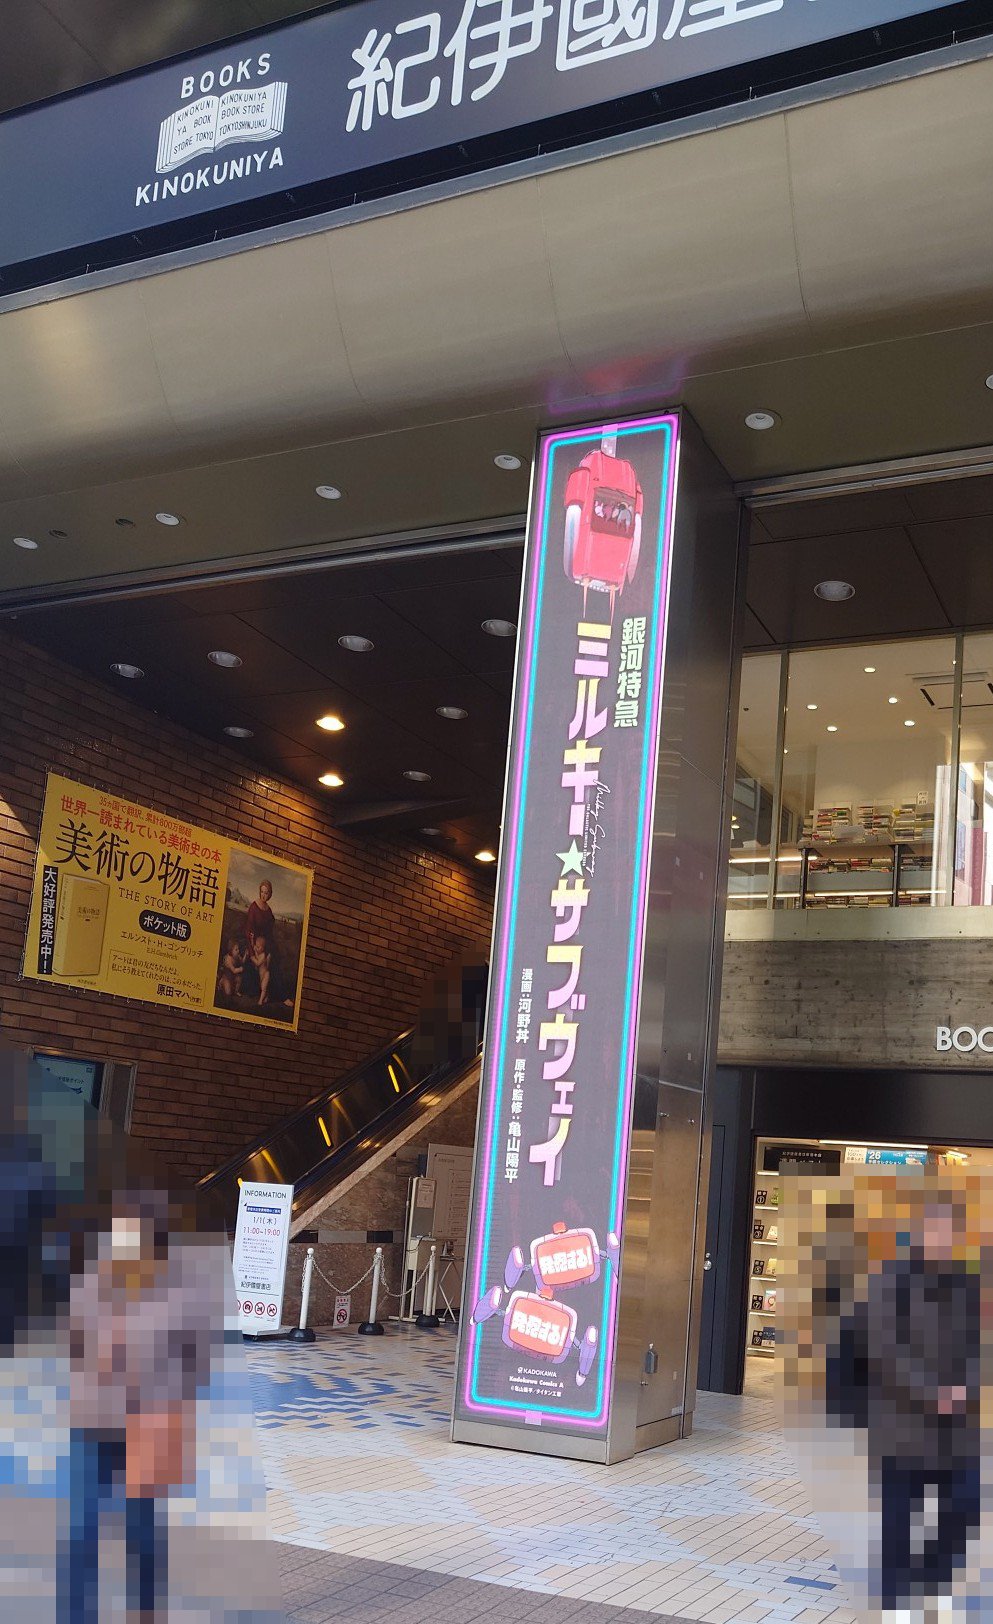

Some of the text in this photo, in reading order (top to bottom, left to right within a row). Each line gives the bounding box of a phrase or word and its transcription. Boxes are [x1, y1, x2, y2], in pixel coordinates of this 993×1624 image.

[181, 53, 270, 98] BOOKS
[221, 91, 267, 107] KINOKUNIYA
[221, 102, 265, 120] BOOK STORE
[177, 114, 212, 136] YA BOOK
[173, 131, 214, 155] STORE TOKYO
[135, 147, 284, 207] KINOKUNIYA
[613, 616, 647, 728] 銀河特急
[60, 794, 222, 864] 世界一読まれている美術史の本
[53, 817, 220, 909] 美術の物語
[118, 887, 215, 924] THE STORY OF ART
[143, 914, 187, 938] ポケット版
[244, 1189, 287, 1199] INFORMATION
[523, 1368, 557, 1378] KADOKAWA
